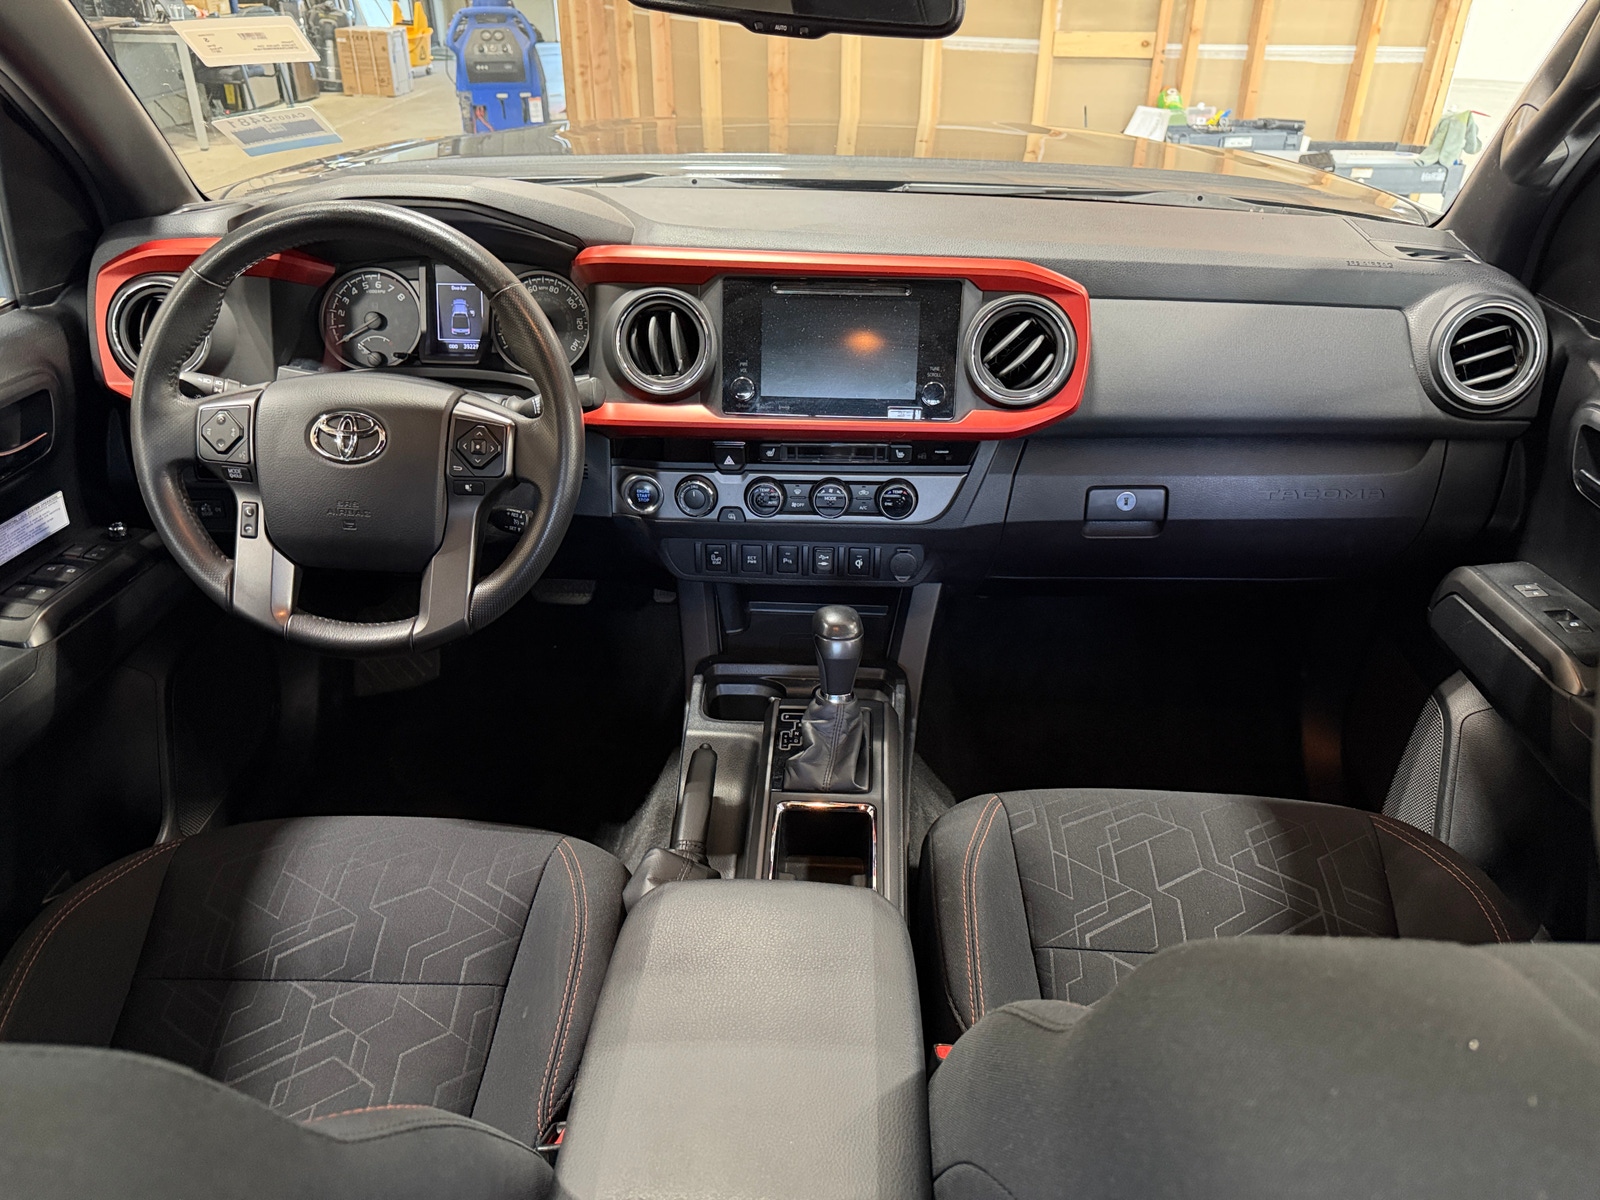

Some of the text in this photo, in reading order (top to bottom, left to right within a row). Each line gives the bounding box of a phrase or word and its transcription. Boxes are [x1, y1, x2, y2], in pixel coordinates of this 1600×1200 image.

[362, 281, 370, 290] 5
[375, 281, 382, 289] 6
[388, 284, 395, 293] 7
[548, 285, 559, 294] 80
[351, 287, 359, 295] 4
[342, 297, 350, 305] 3
[397, 293, 406, 302] 8
[566, 297, 578, 310] 100
[337, 309, 346, 317] 2
[576, 318, 584, 331] 120
[570, 338, 581, 352] 140
[1259, 489, 1386, 501] TACOMA
